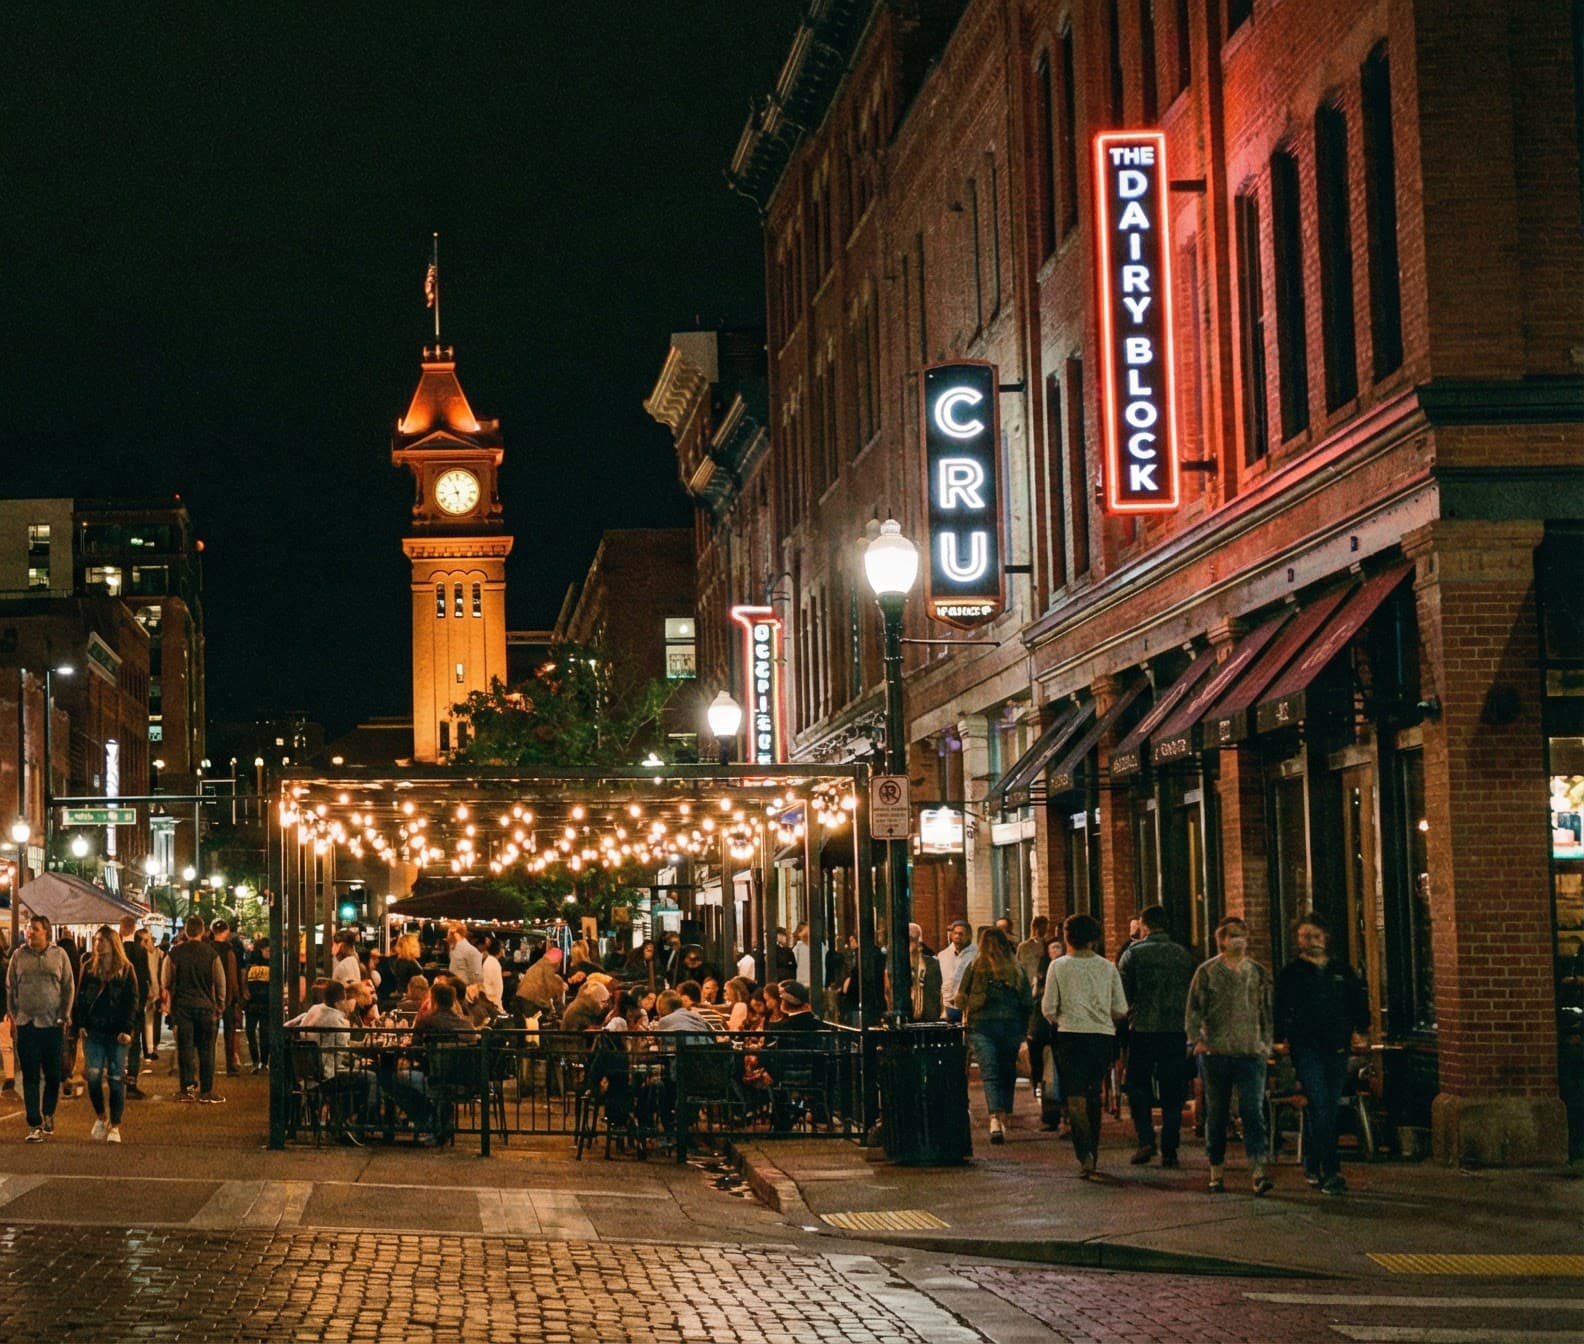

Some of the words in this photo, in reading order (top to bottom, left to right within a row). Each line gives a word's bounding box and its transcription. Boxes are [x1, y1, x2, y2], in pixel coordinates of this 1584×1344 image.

[1109, 147, 1154, 165] THE
[1118, 170, 1151, 324] DAIRY
[934, 386, 989, 583] CRU
[1124, 337, 1158, 491] BLOCK
